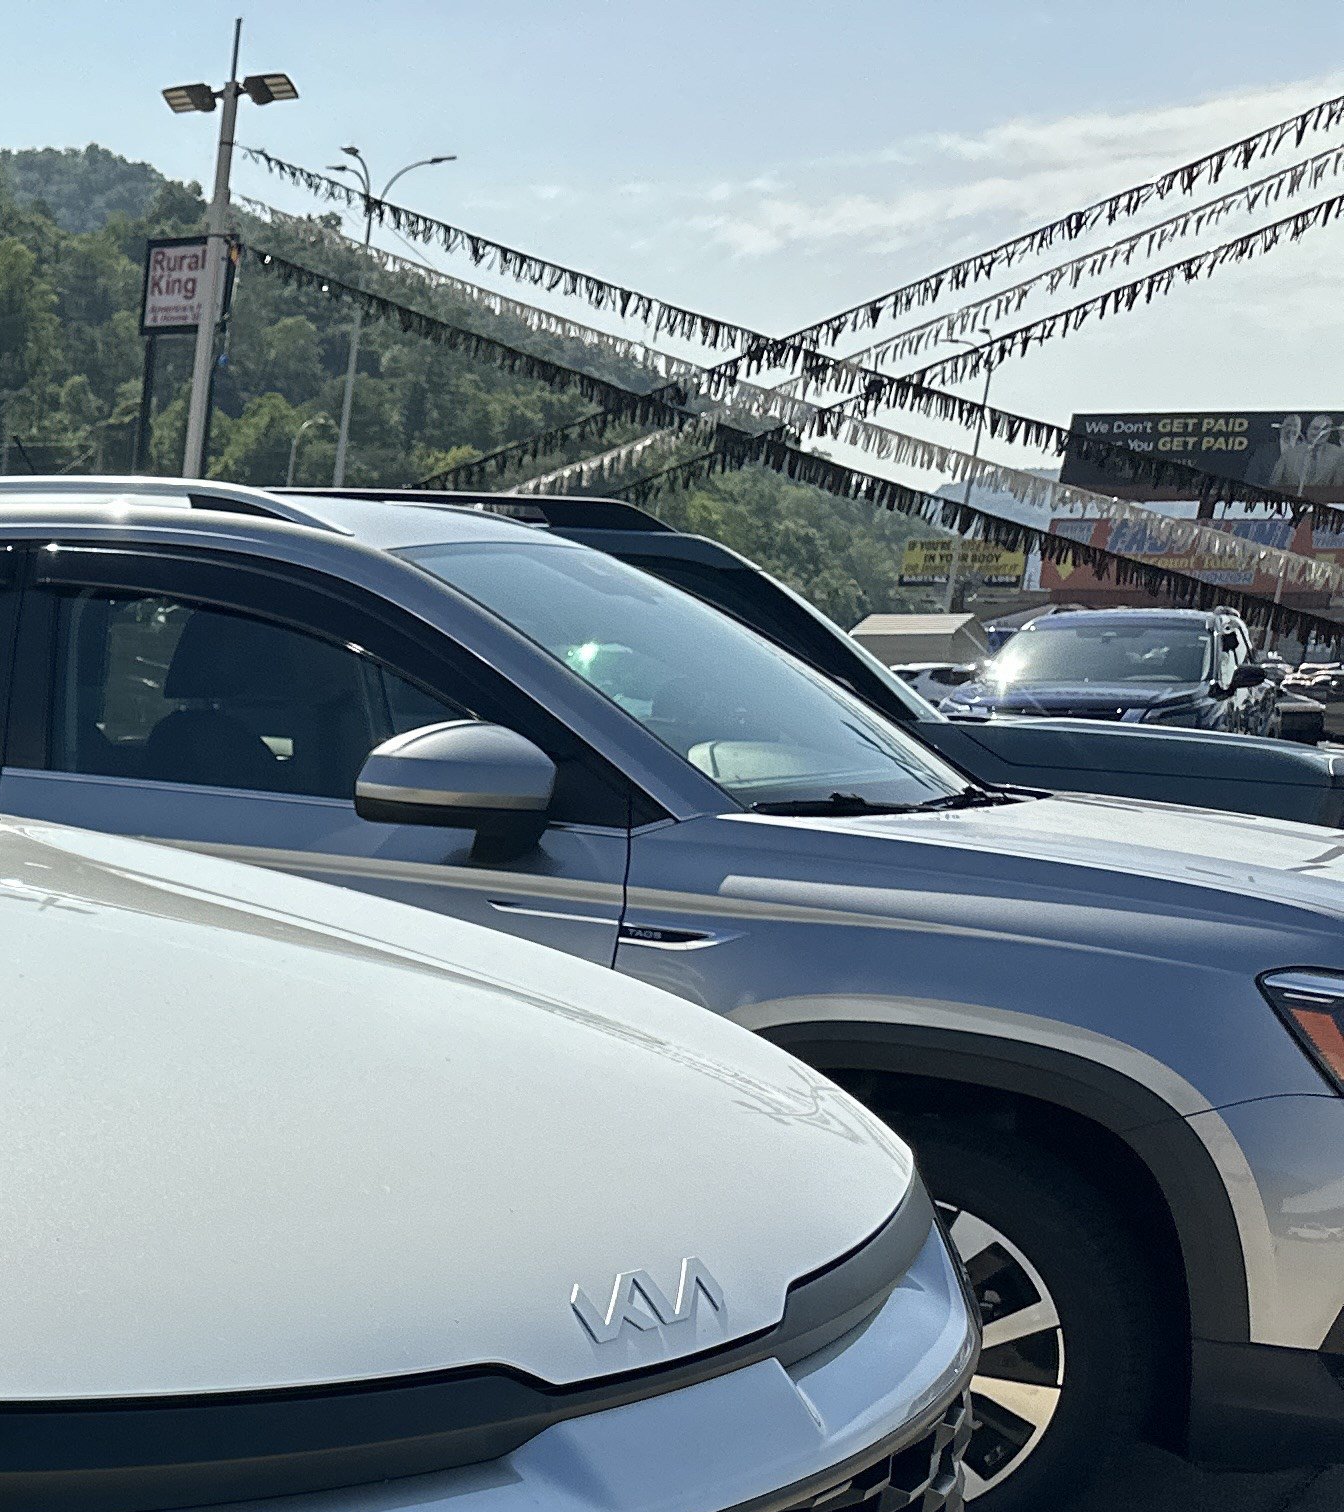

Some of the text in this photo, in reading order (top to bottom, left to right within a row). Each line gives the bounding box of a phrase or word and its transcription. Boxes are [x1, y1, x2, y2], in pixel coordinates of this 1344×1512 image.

[152, 248, 206, 272] Rural
[150, 273, 197, 298] King
[1085, 418, 1249, 434] We Don't GET PAID
[1127, 438, 1154, 452] You
[1157, 437, 1199, 451] GET
[1201, 437, 1249, 451] PAID
[939, 553, 970, 563] YOR
